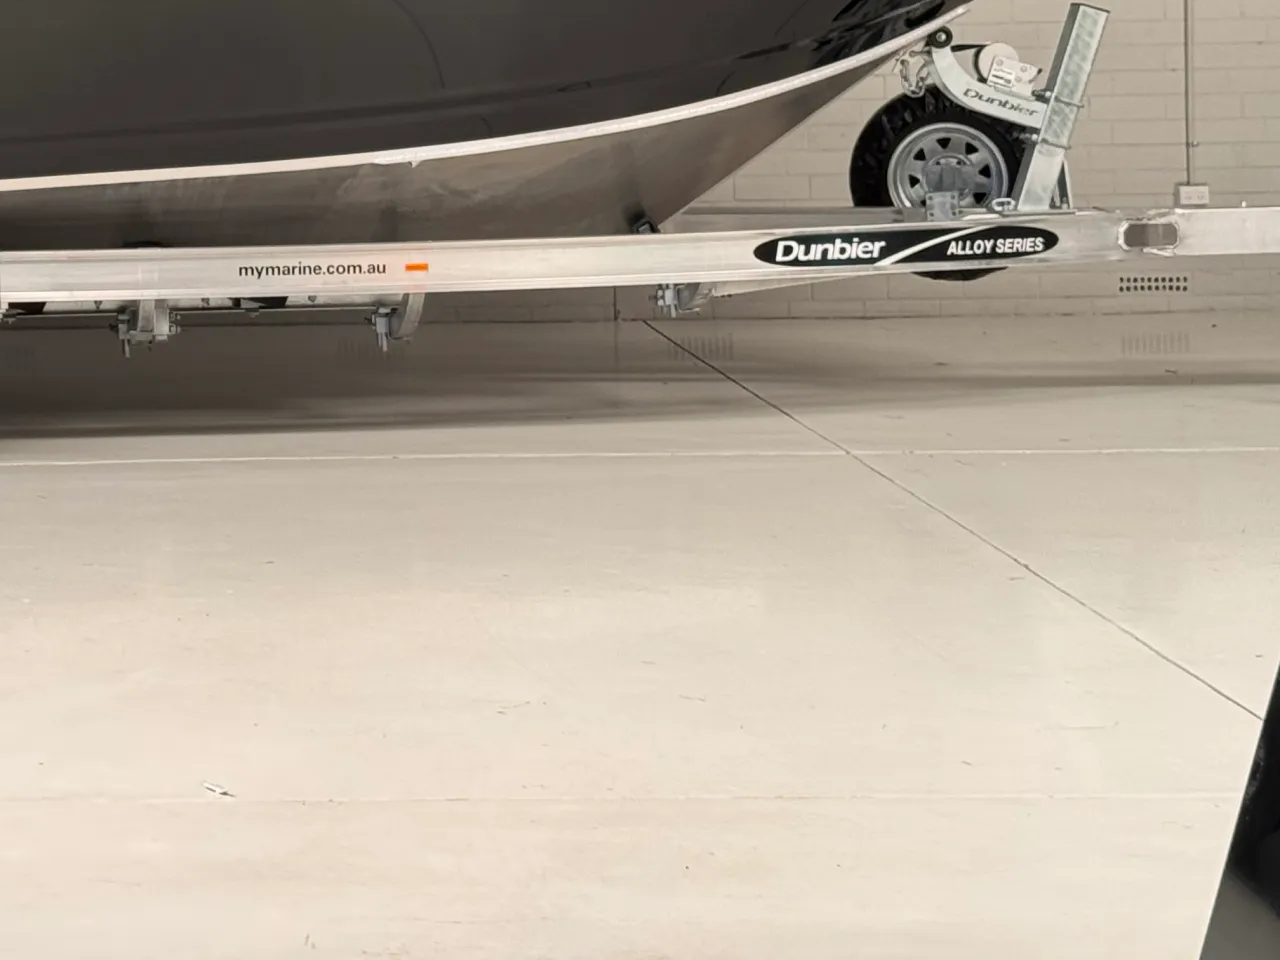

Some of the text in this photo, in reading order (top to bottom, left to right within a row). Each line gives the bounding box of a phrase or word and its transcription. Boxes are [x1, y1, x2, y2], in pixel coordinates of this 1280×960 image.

[963, 88, 1039, 116] Dunbier
[775, 237, 1044, 262] Dunbier ALLOY SERIES
[238, 261, 386, 279] mymarine.com.au
